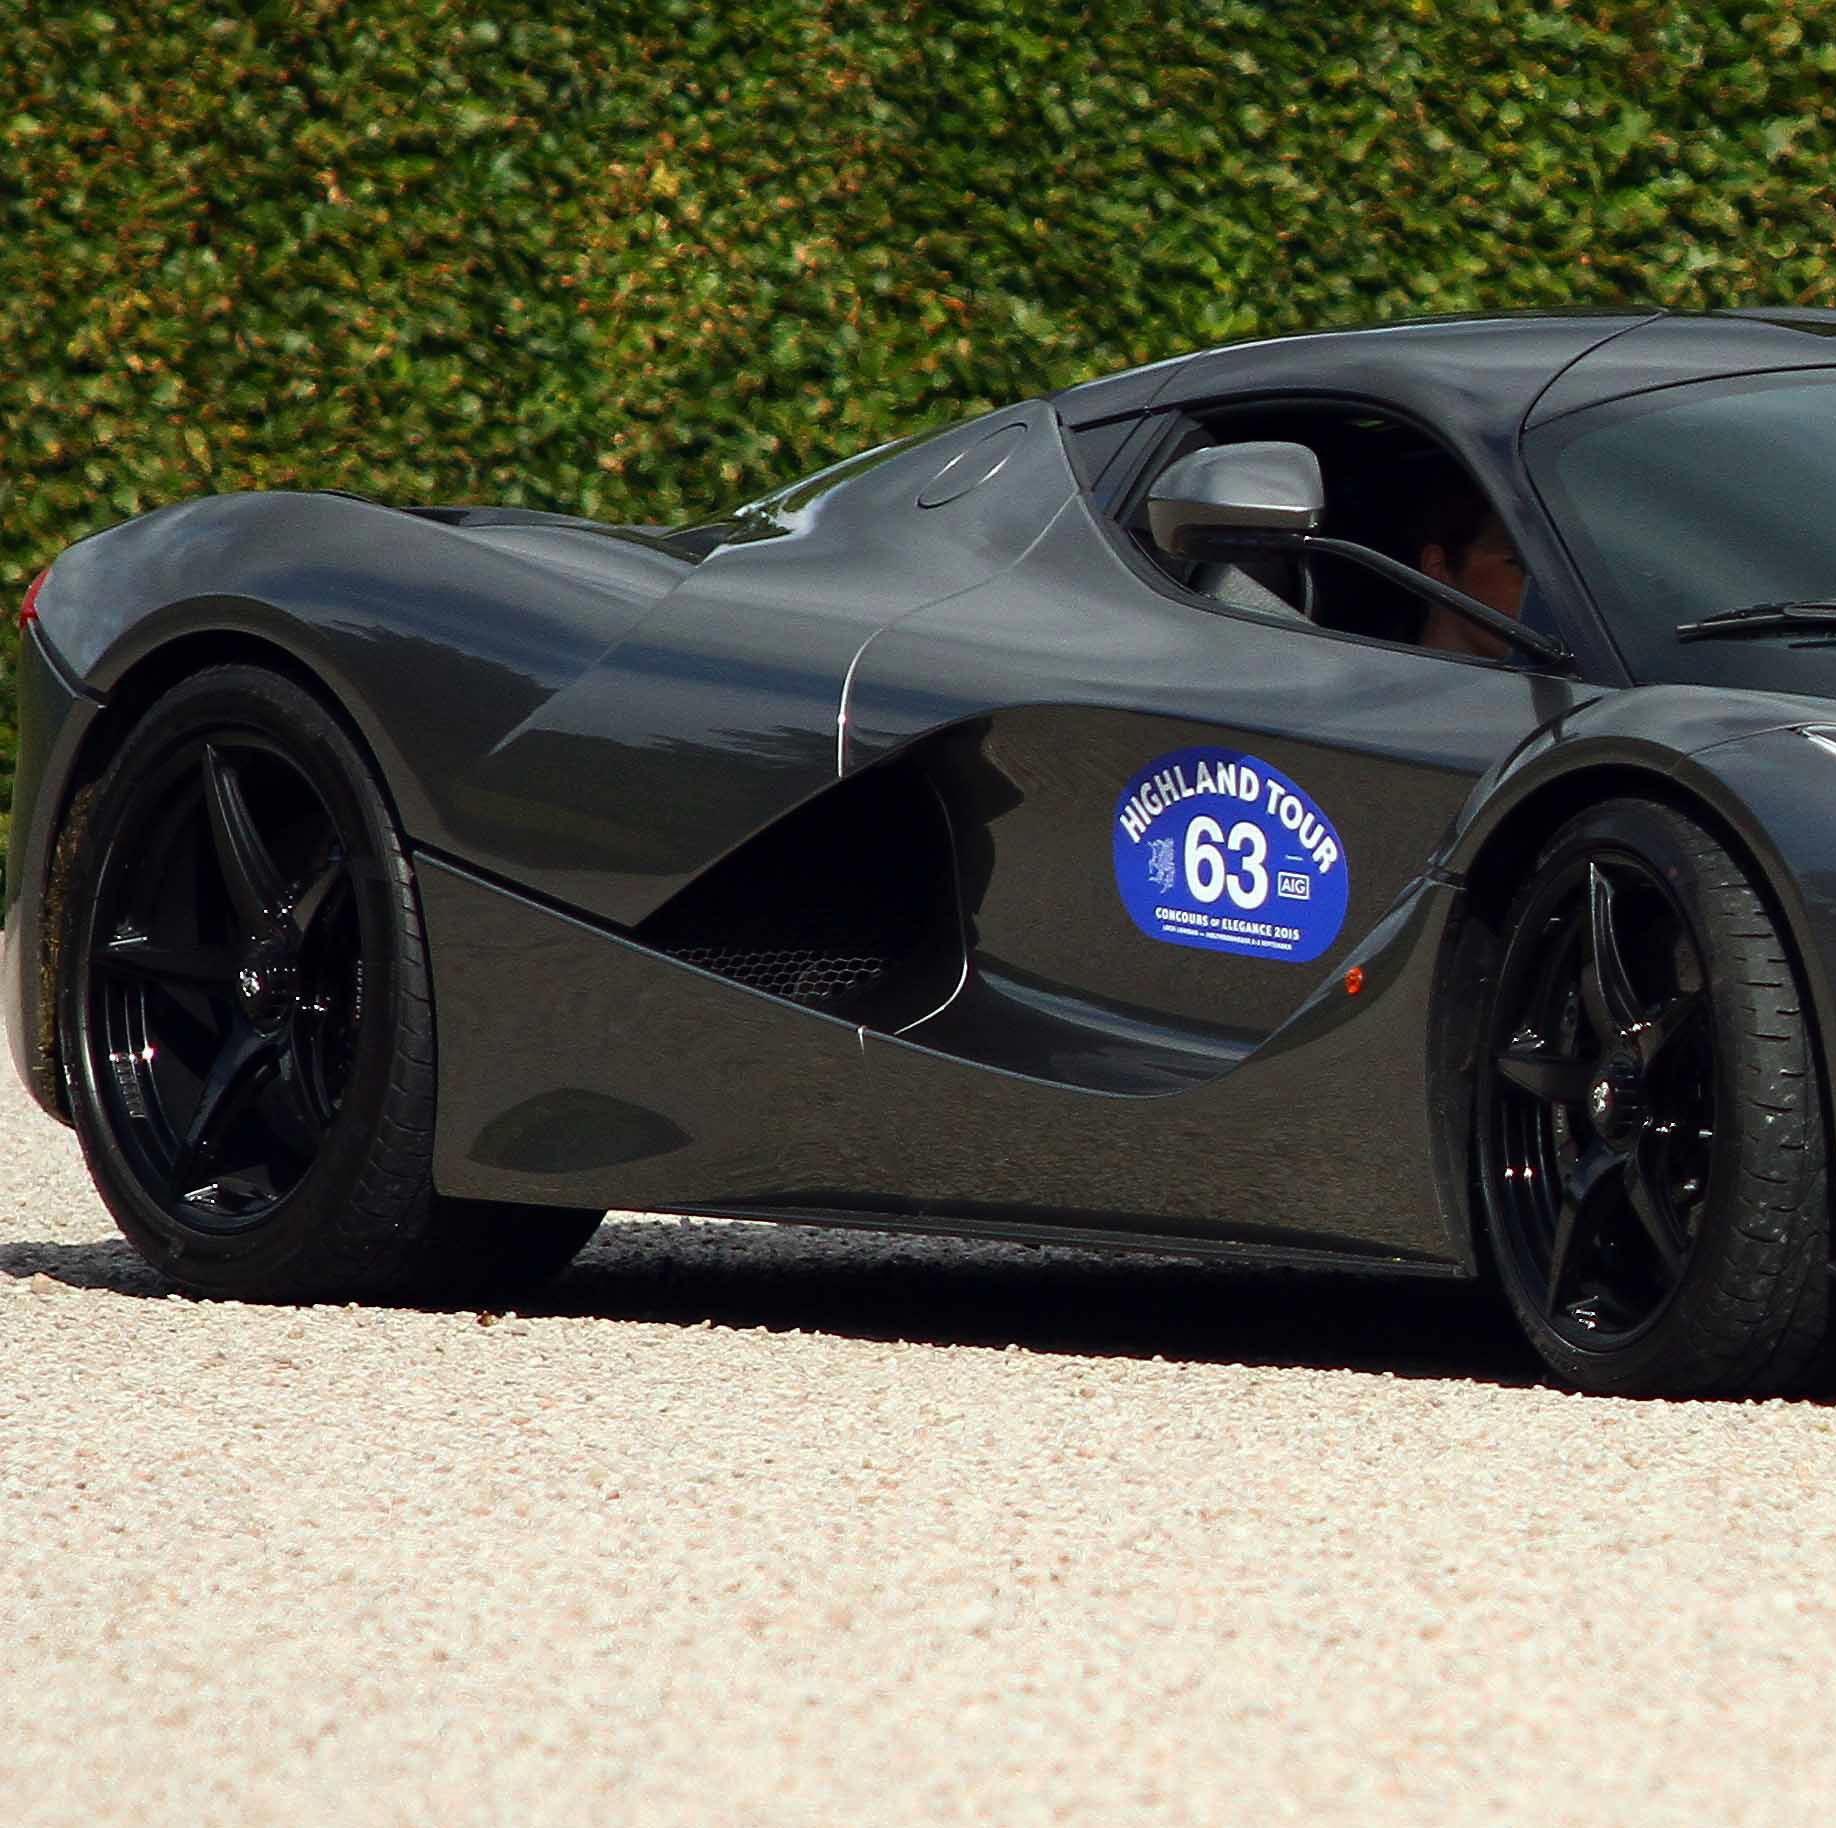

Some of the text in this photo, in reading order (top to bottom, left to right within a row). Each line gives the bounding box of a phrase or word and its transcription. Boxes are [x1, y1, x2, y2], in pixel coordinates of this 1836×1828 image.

[1119, 761, 1338, 873] HIGHLAND TOUR
[1184, 815, 1268, 910] 63
[1281, 878, 1306, 894] AIG
[1155, 907, 1208, 926] CONCOURS
[1222, 918, 1272, 937] ELEGANCE
[1274, 926, 1300, 940] 2015
